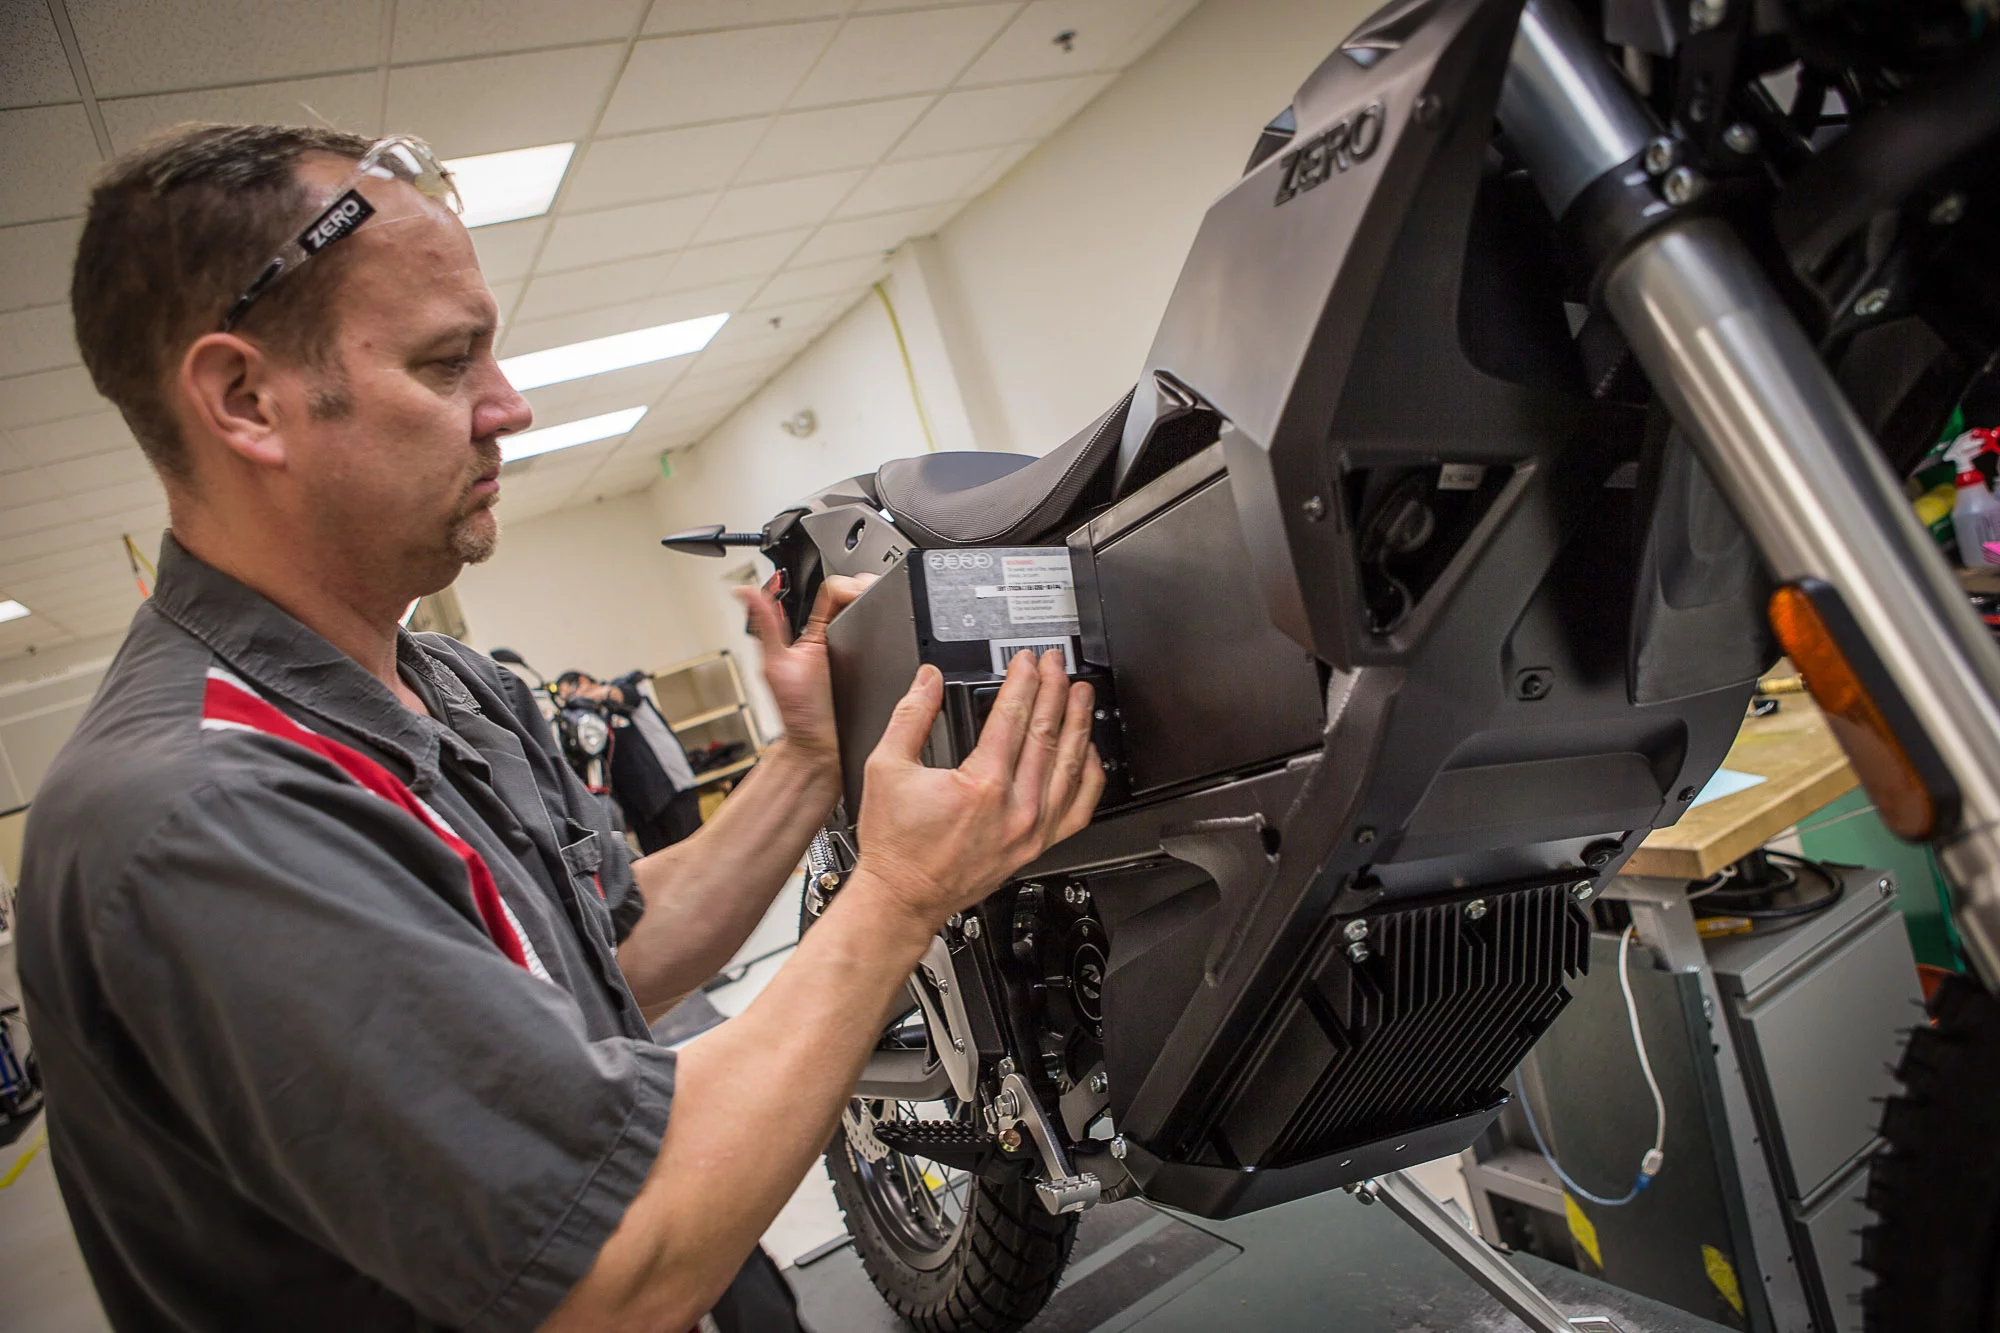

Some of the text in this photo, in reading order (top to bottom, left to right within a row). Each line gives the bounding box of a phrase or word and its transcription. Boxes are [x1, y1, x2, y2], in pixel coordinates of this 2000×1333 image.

[1274, 102, 1386, 207] ZERO
[307, 199, 360, 249] ZERO
[929, 552, 993, 570] ZERO
